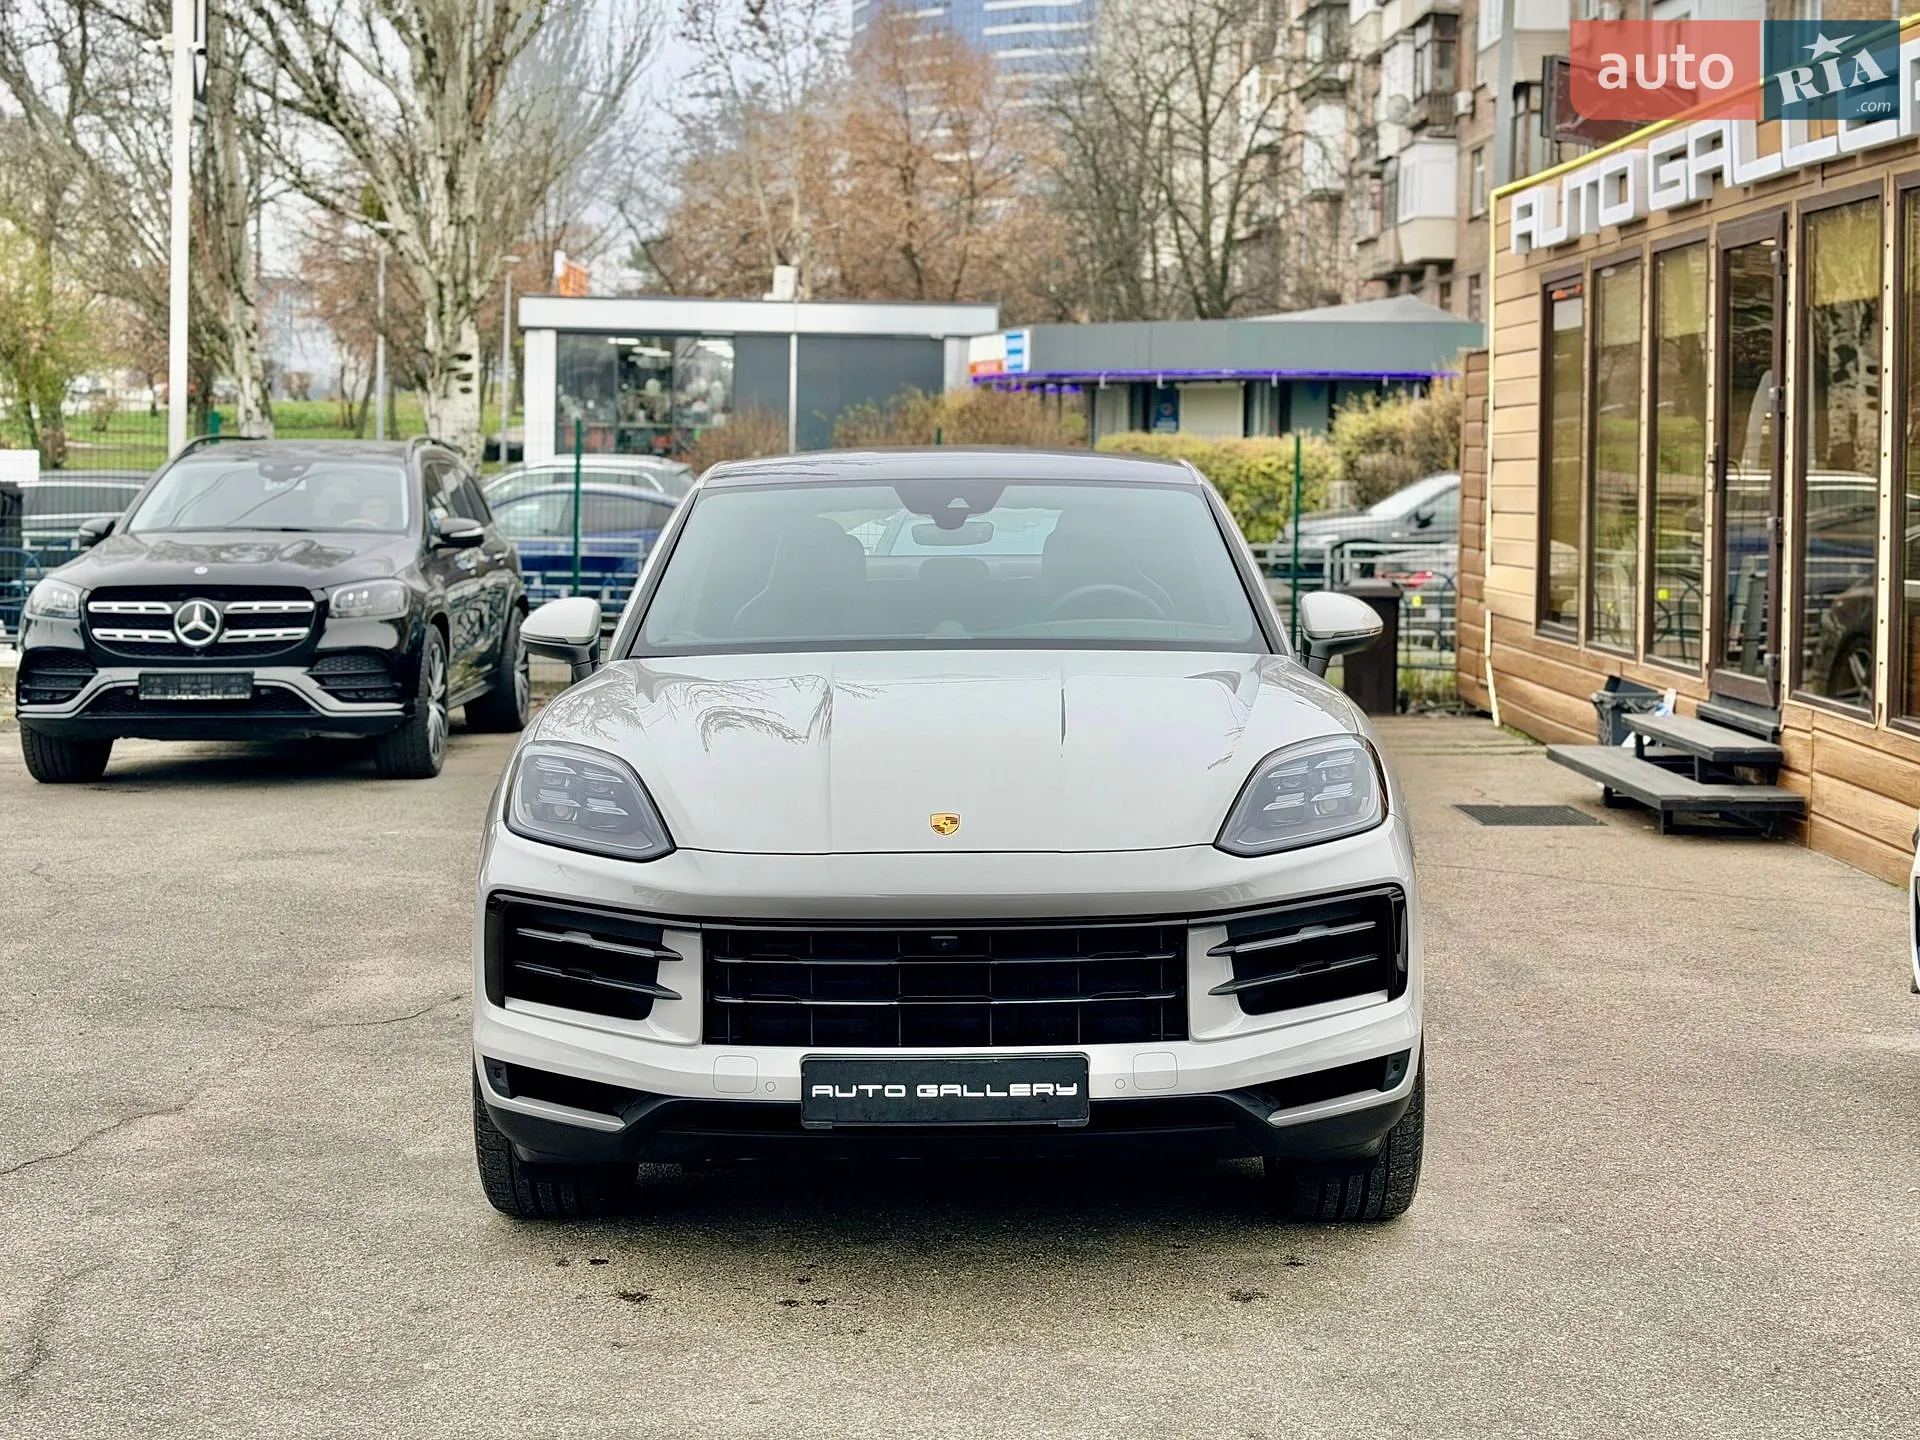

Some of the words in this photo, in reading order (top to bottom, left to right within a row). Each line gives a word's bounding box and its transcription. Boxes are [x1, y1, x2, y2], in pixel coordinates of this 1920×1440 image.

[1511, 150, 1642, 255] AUTO
[811, 1084, 906, 1098] AUTO
[916, 1082, 1078, 1097] GALLERY
